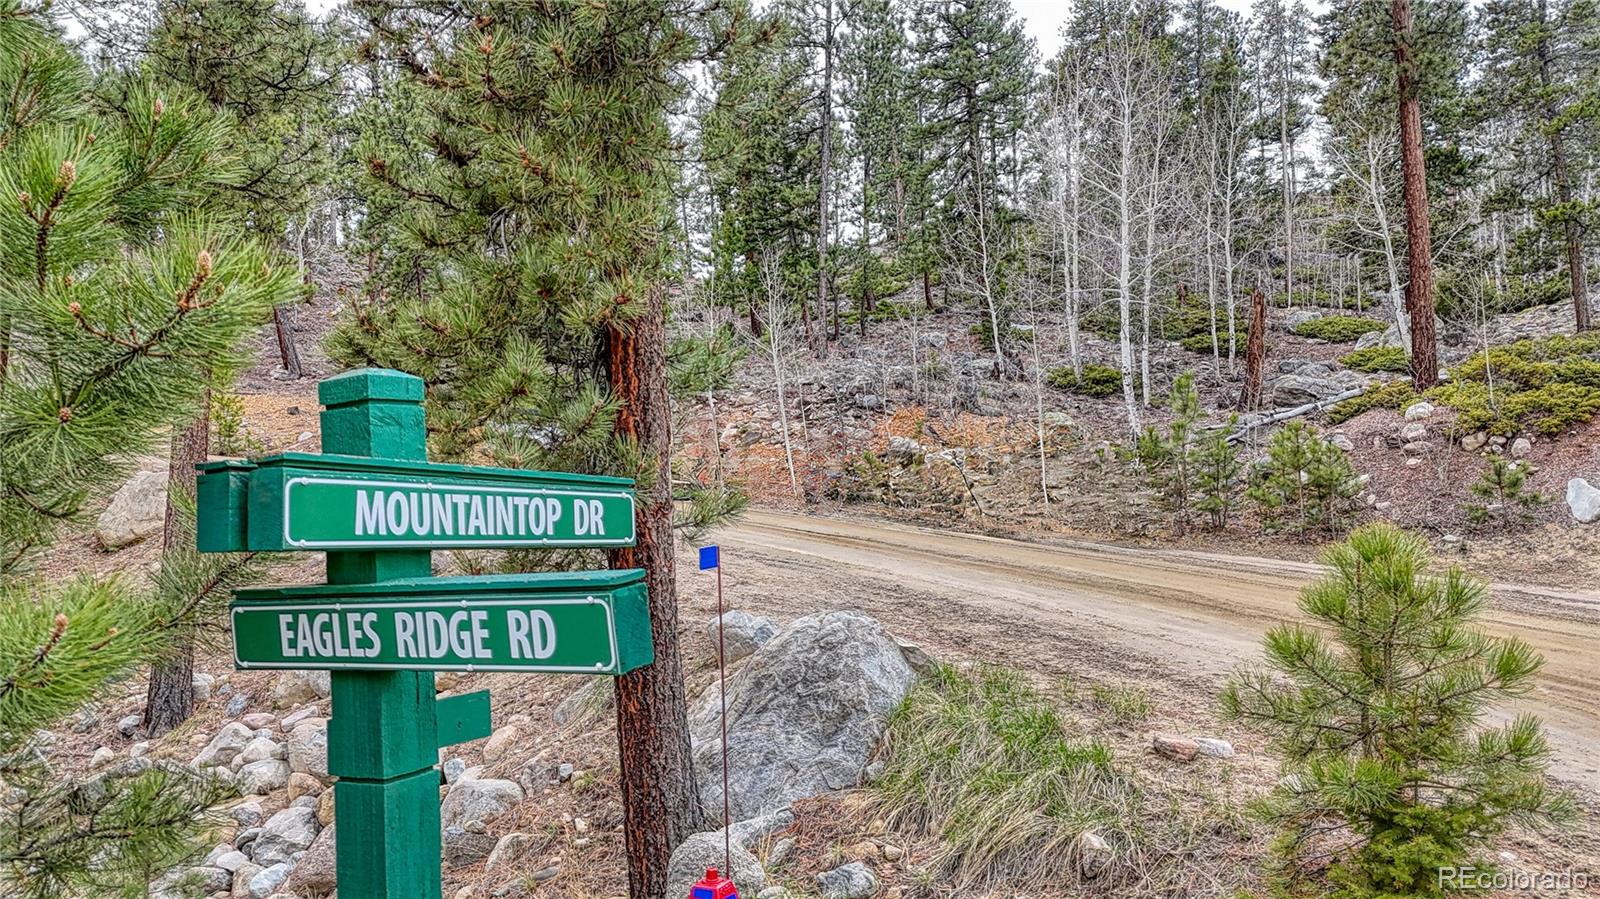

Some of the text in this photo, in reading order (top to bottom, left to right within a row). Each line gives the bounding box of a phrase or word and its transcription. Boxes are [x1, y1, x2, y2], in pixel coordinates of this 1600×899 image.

[354, 489, 605, 537] MOUNTAINTOP DR
[278, 608, 557, 661] EAGLES RIDGE RD
